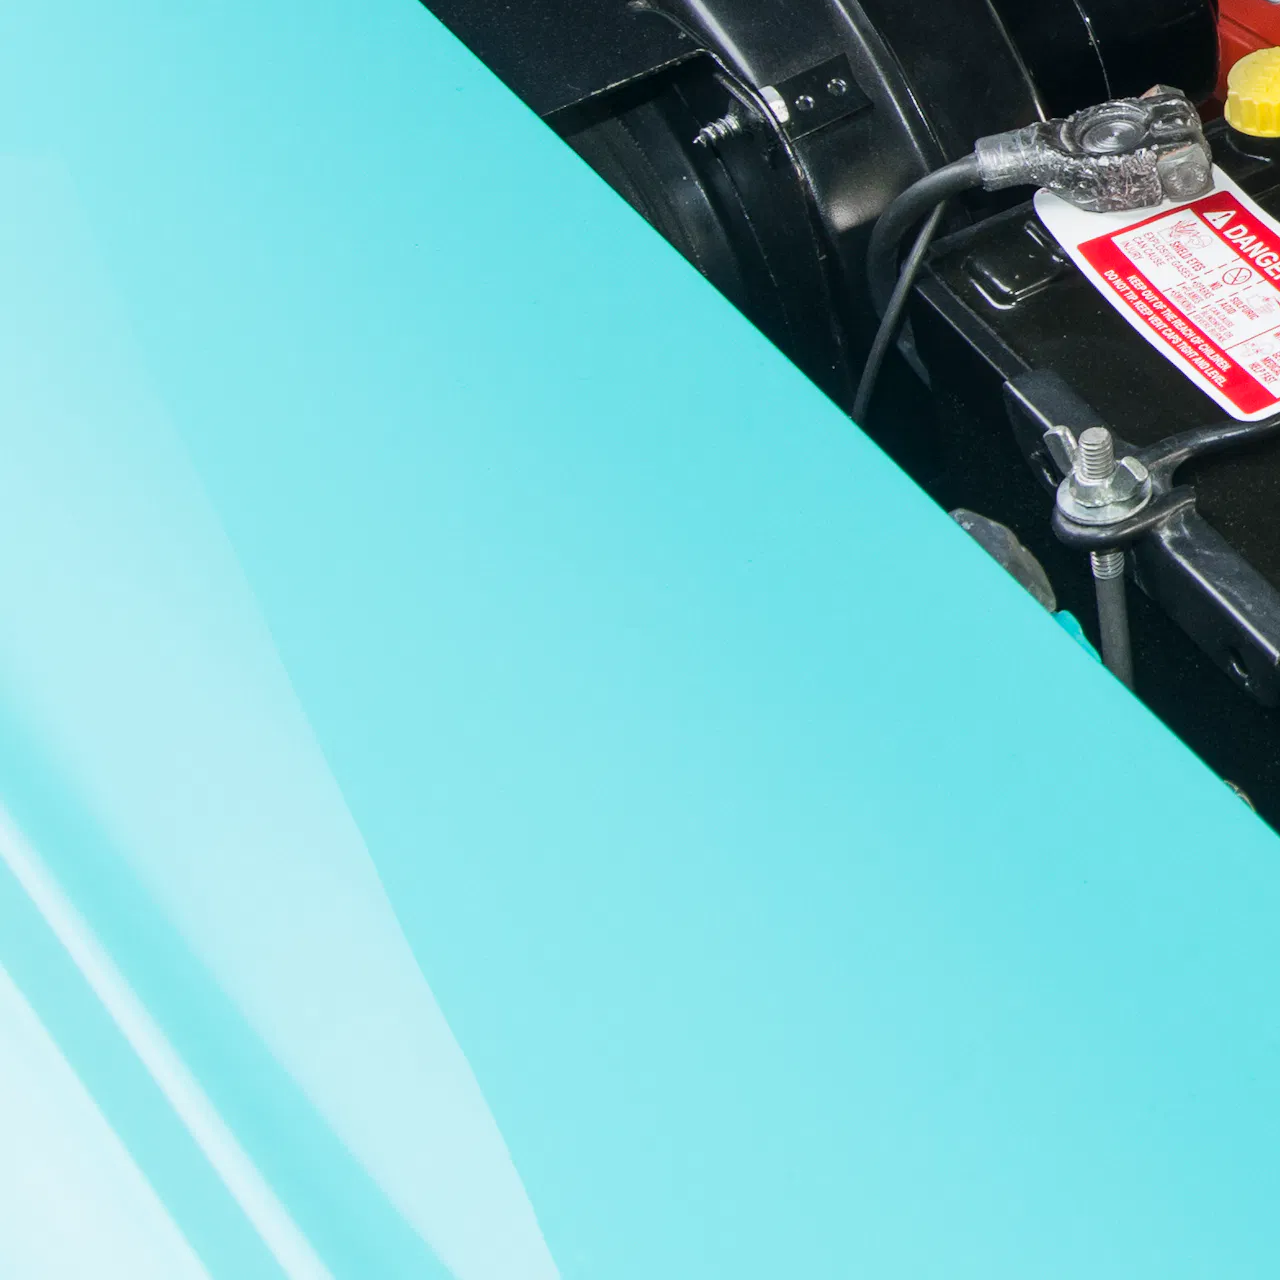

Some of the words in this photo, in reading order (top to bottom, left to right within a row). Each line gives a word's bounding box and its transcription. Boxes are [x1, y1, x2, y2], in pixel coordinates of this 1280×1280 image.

[1132, 236, 1147, 249] CAN
[1143, 248, 1165, 266] CAUSE
[1143, 231, 1175, 261] EXPLOSIVE
[1171, 260, 1193, 278] GASES
[1169, 240, 1192, 259] SHIELD
[1186, 257, 1205, 271] EYES
[1103, 269, 1118, 280] DO
[1112, 278, 1130, 291] NOT
[1133, 300, 1153, 315] KEEP
[1148, 314, 1168, 329] VENT
[1161, 328, 1182, 344] CAPS
[1176, 341, 1198, 358] TIGHT
[1192, 356, 1210, 369] AND
[1127, 274, 1147, 290] KEEP
[1141, 289, 1159, 302] OUT
[1152, 300, 1167, 309] OF
[1160, 307, 1177, 321] THE
[1171, 318, 1195, 338] REACH
[1190, 335, 1204, 344] OF
[1198, 343, 1230, 371] CHILDREN.
[1220, 302, 1236, 314] ACID
[1230, 296, 1258, 320] SULFURIC
